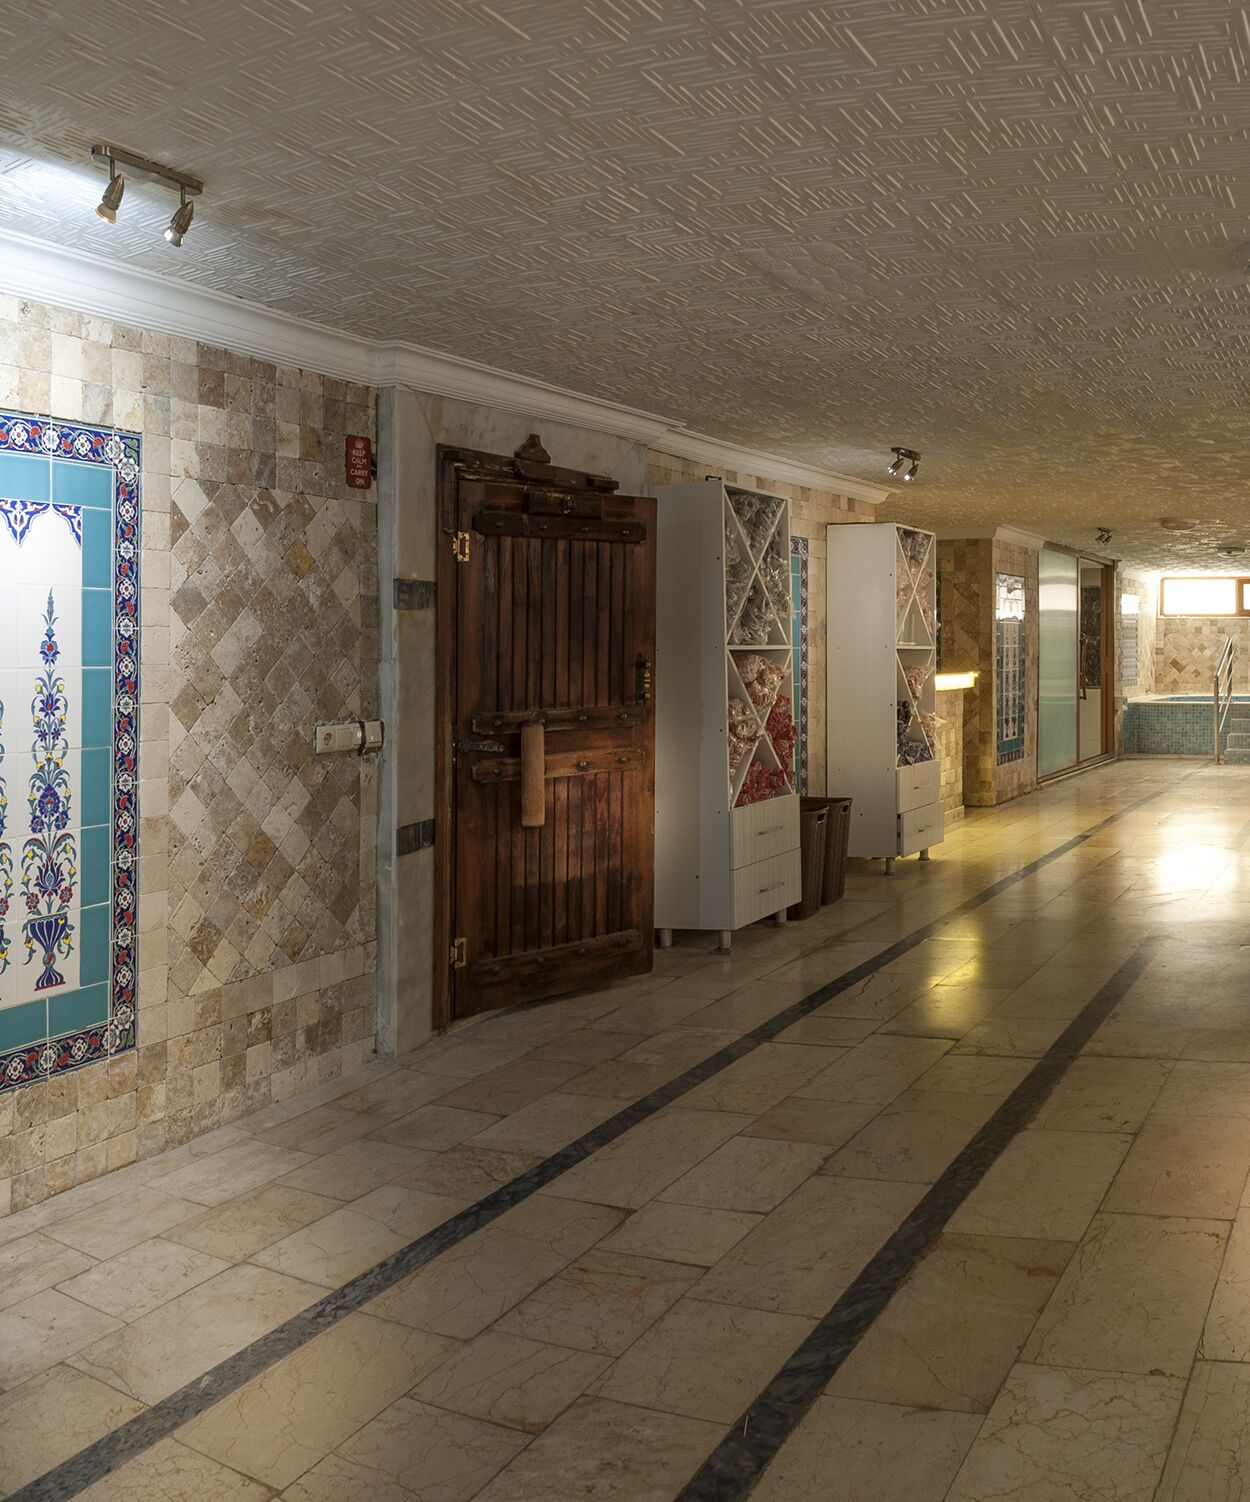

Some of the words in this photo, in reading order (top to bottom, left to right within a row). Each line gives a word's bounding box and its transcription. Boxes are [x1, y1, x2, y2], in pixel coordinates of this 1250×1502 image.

[352, 449, 366, 457] KEEP
[351, 456, 367, 465] CALM
[350, 468, 369, 477] CARRY
[355, 477, 365, 485] ON
